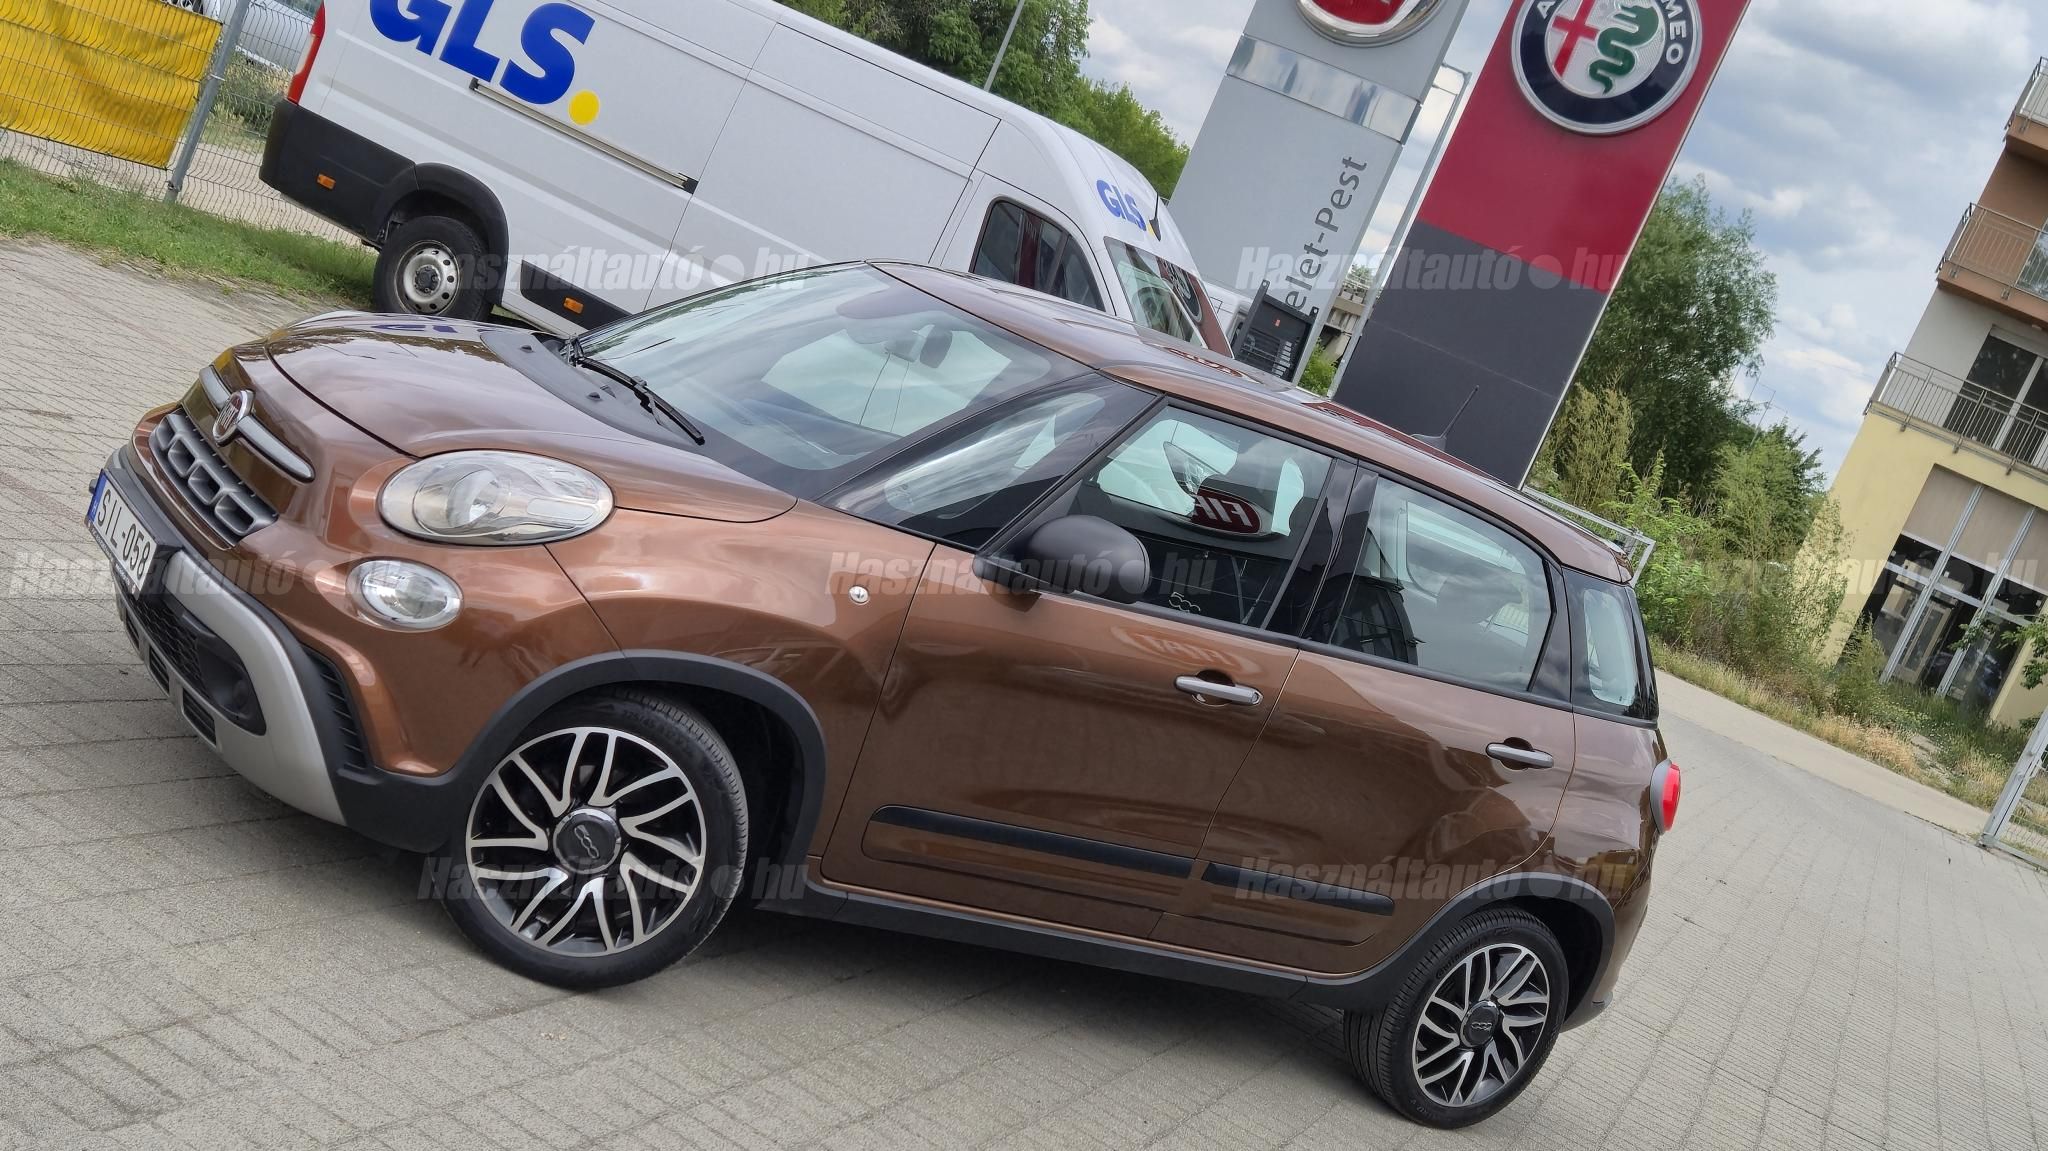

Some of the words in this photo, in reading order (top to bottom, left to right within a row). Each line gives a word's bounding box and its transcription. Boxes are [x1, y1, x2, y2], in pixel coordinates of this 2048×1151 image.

[1661, 0, 1687, 65] MEO
[1285, 156, 1368, 311] elet-Pest
[97, 488, 151, 581] SIL-058
